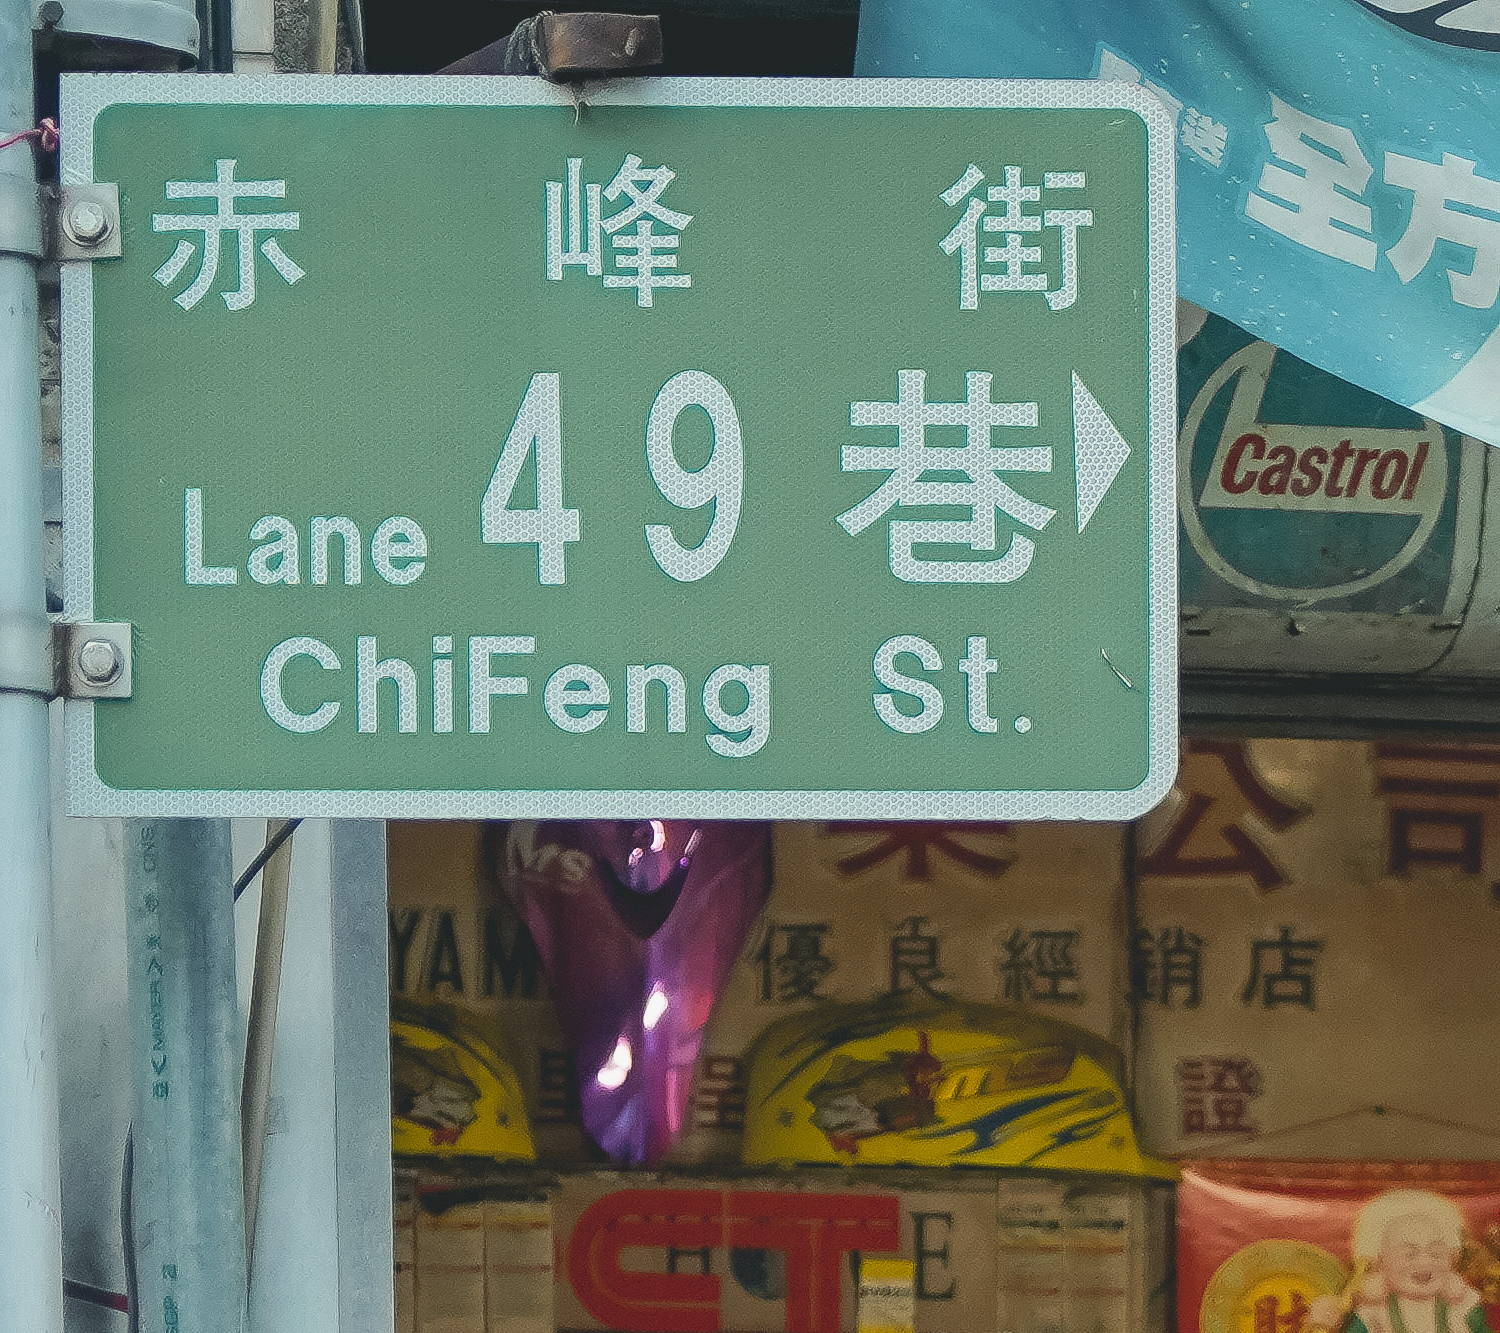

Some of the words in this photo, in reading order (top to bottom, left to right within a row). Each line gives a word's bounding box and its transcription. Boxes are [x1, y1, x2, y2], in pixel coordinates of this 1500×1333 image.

[152, 153, 1094, 311] 赤峰街
[184, 487, 428, 586] Lane
[481, 370, 746, 586] 49
[837, 369, 1057, 585] 巷
[1219, 431, 1430, 505] Castrol
[259, 635, 773, 757] ChiFeng
[872, 634, 1032, 733] St.
[750, 920, 1324, 1012] 優良經銷店
[161, 1264, 178, 1279] 2
